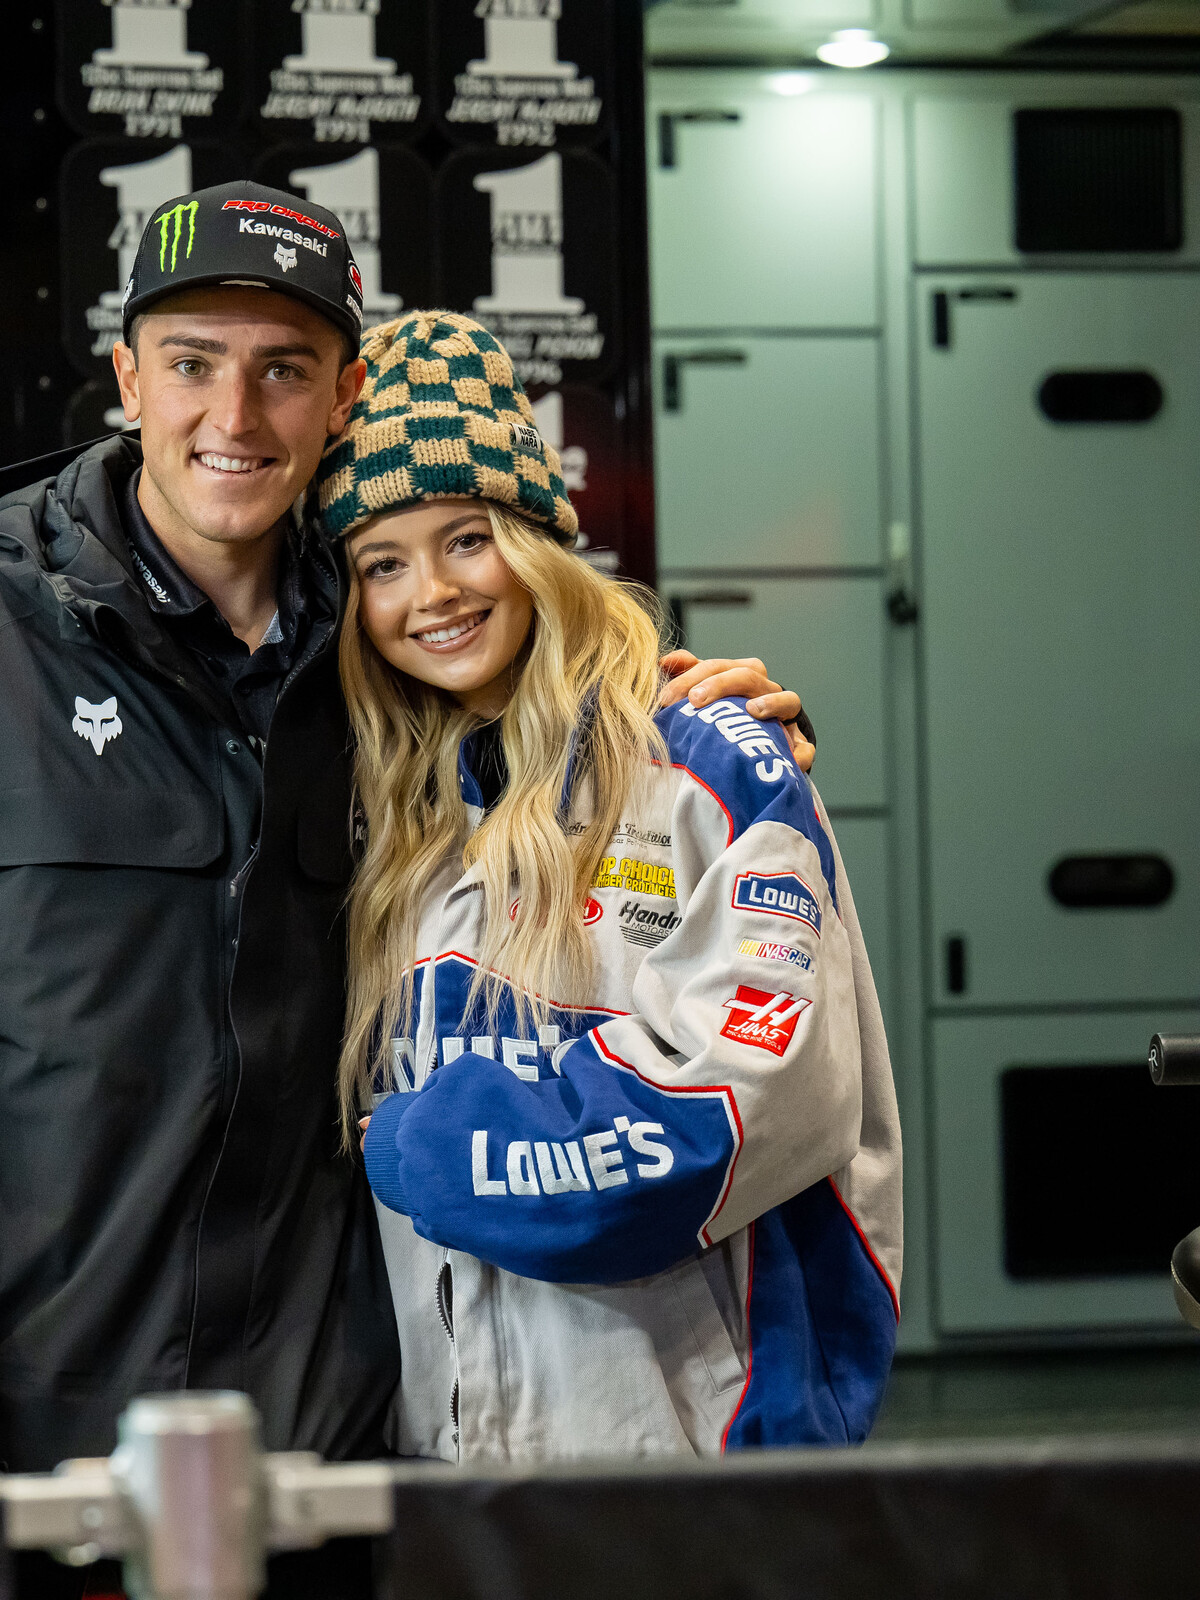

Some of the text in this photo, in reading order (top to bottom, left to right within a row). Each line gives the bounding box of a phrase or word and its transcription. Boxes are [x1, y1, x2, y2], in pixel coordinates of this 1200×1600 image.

[221, 200, 271, 212] PRO
[270, 204, 340, 240] CIRCUIT
[239, 218, 328, 258] Kawasaki
[599, 857, 616, 875] OP
[625, 878, 676, 899] PRODUCTS
[749, 881, 817, 923] LOWE'S
[760, 943, 810, 971] NASCAR
[729, 1021, 789, 1040] HAAS
[471, 1116, 675, 1197] LOWE'S
